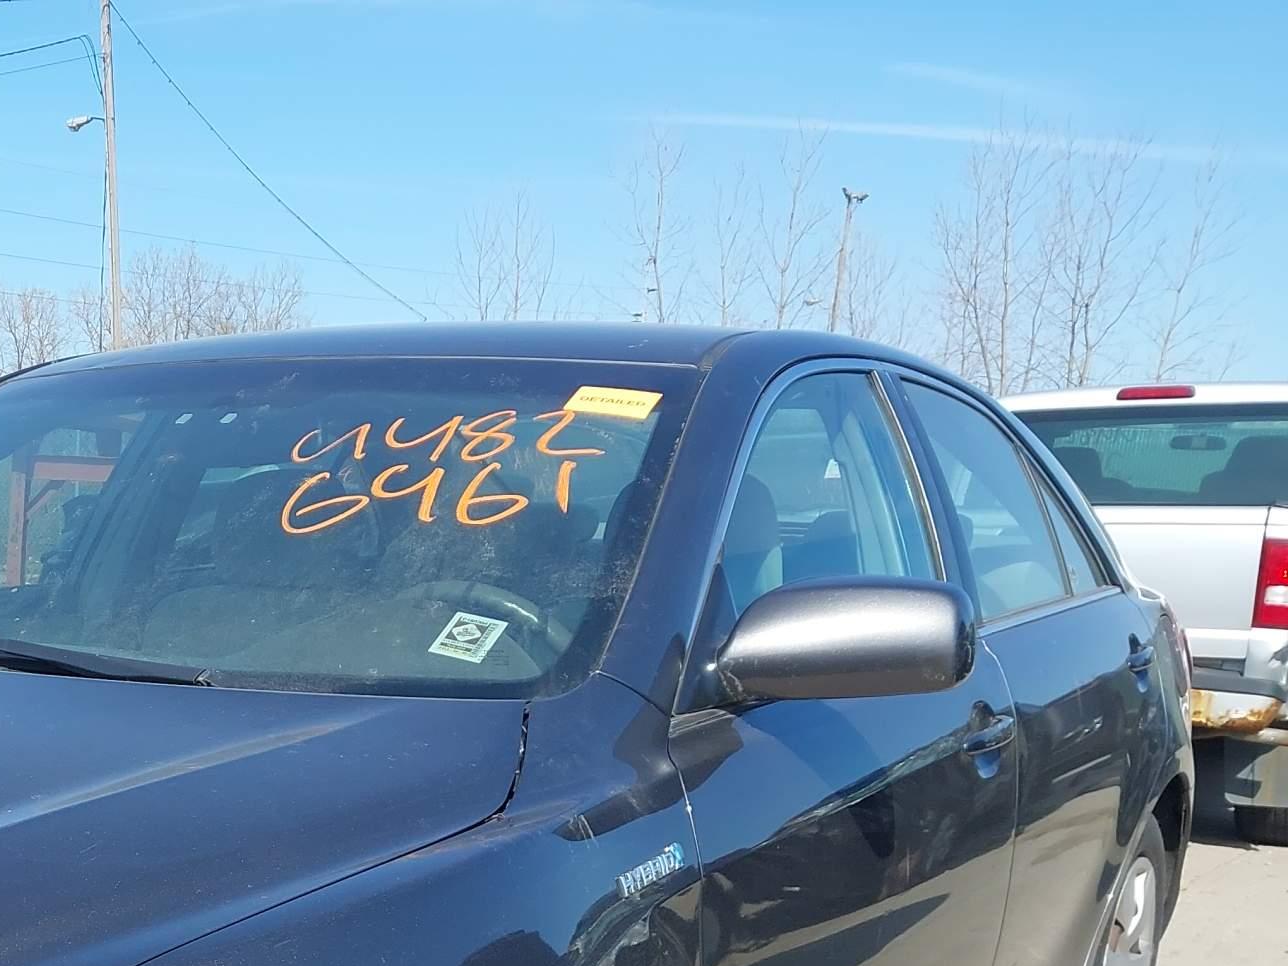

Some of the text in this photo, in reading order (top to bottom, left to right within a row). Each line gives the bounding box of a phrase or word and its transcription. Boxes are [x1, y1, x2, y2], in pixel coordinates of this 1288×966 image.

[579, 395, 646, 407] DETAILED
[290, 410, 606, 463] 4482
[281, 460, 577, 535] 6461
[617, 849, 676, 898] HYBRID
